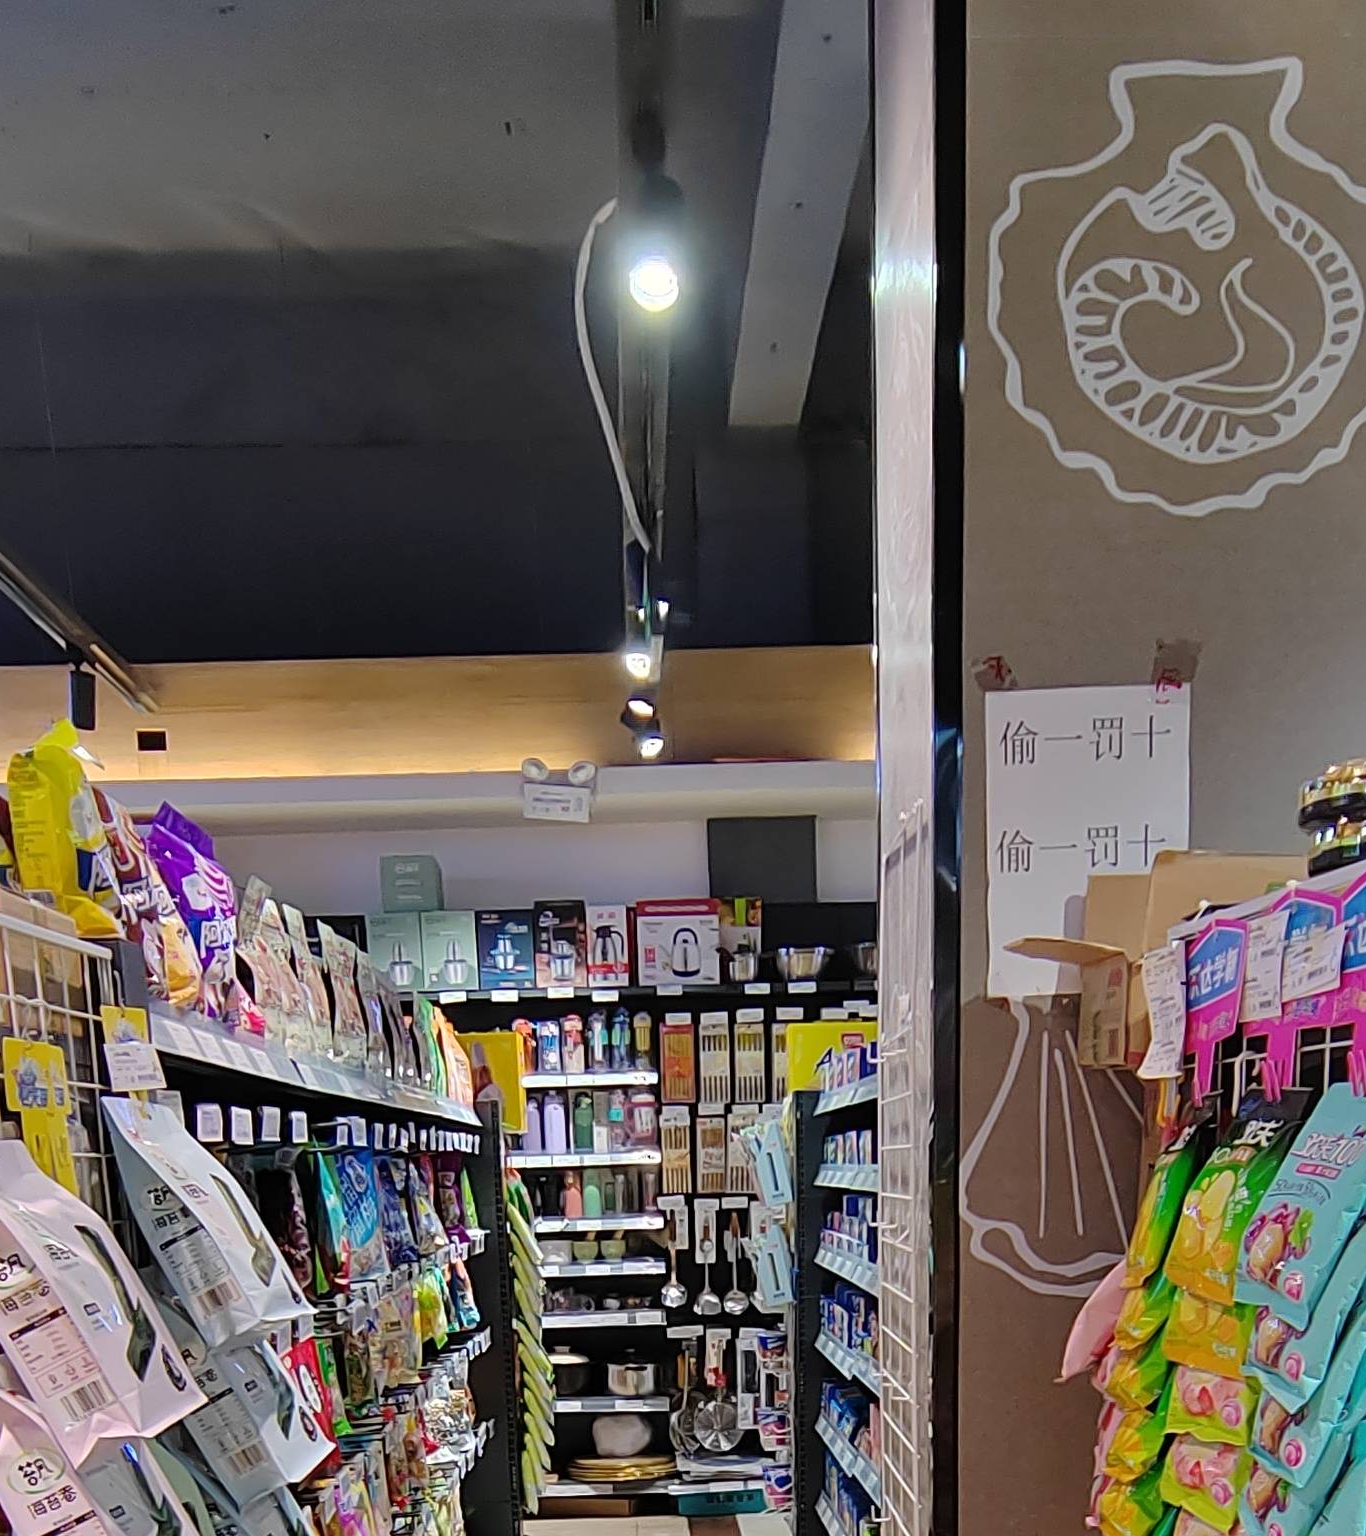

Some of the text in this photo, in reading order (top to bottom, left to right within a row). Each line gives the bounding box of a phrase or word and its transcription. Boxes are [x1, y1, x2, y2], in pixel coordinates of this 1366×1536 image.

[999, 714, 1172, 766] 偷一罚十
[995, 824, 1167, 874] 偷一罚十
